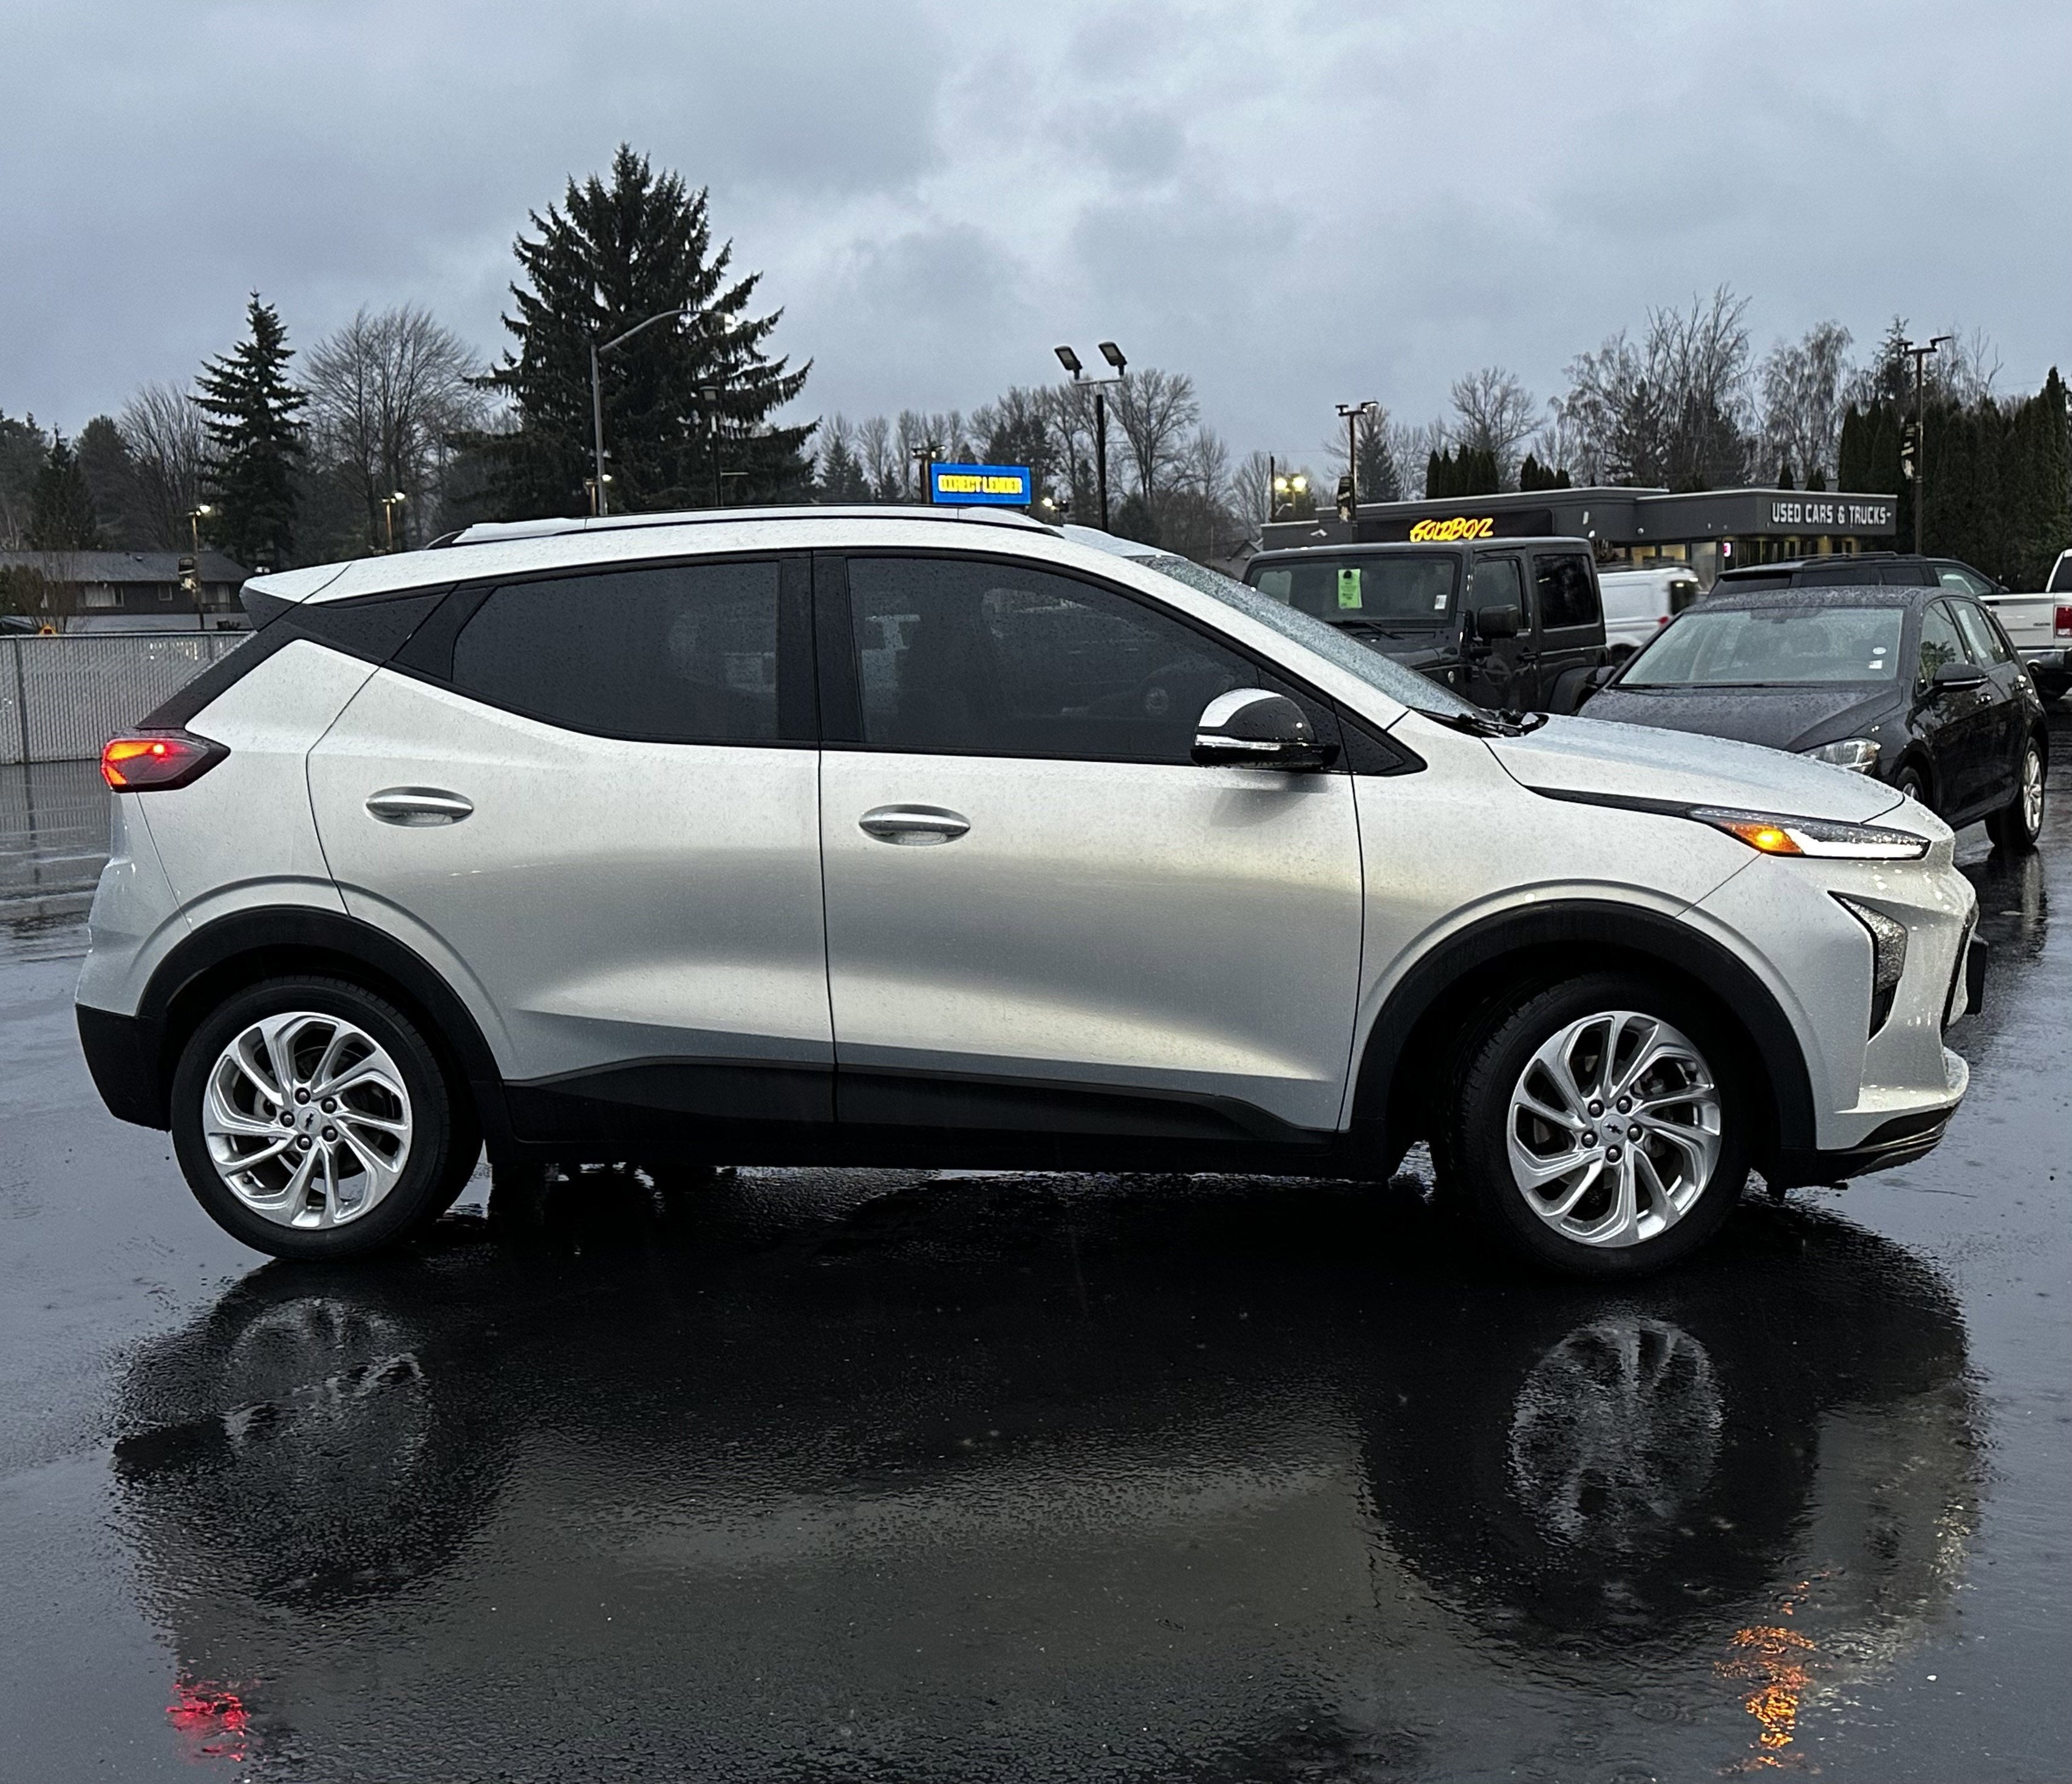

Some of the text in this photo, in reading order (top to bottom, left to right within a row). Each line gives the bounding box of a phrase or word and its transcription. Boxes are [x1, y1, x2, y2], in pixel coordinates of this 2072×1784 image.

[1772, 502, 1886, 525] USED CARS & TRUCKS
